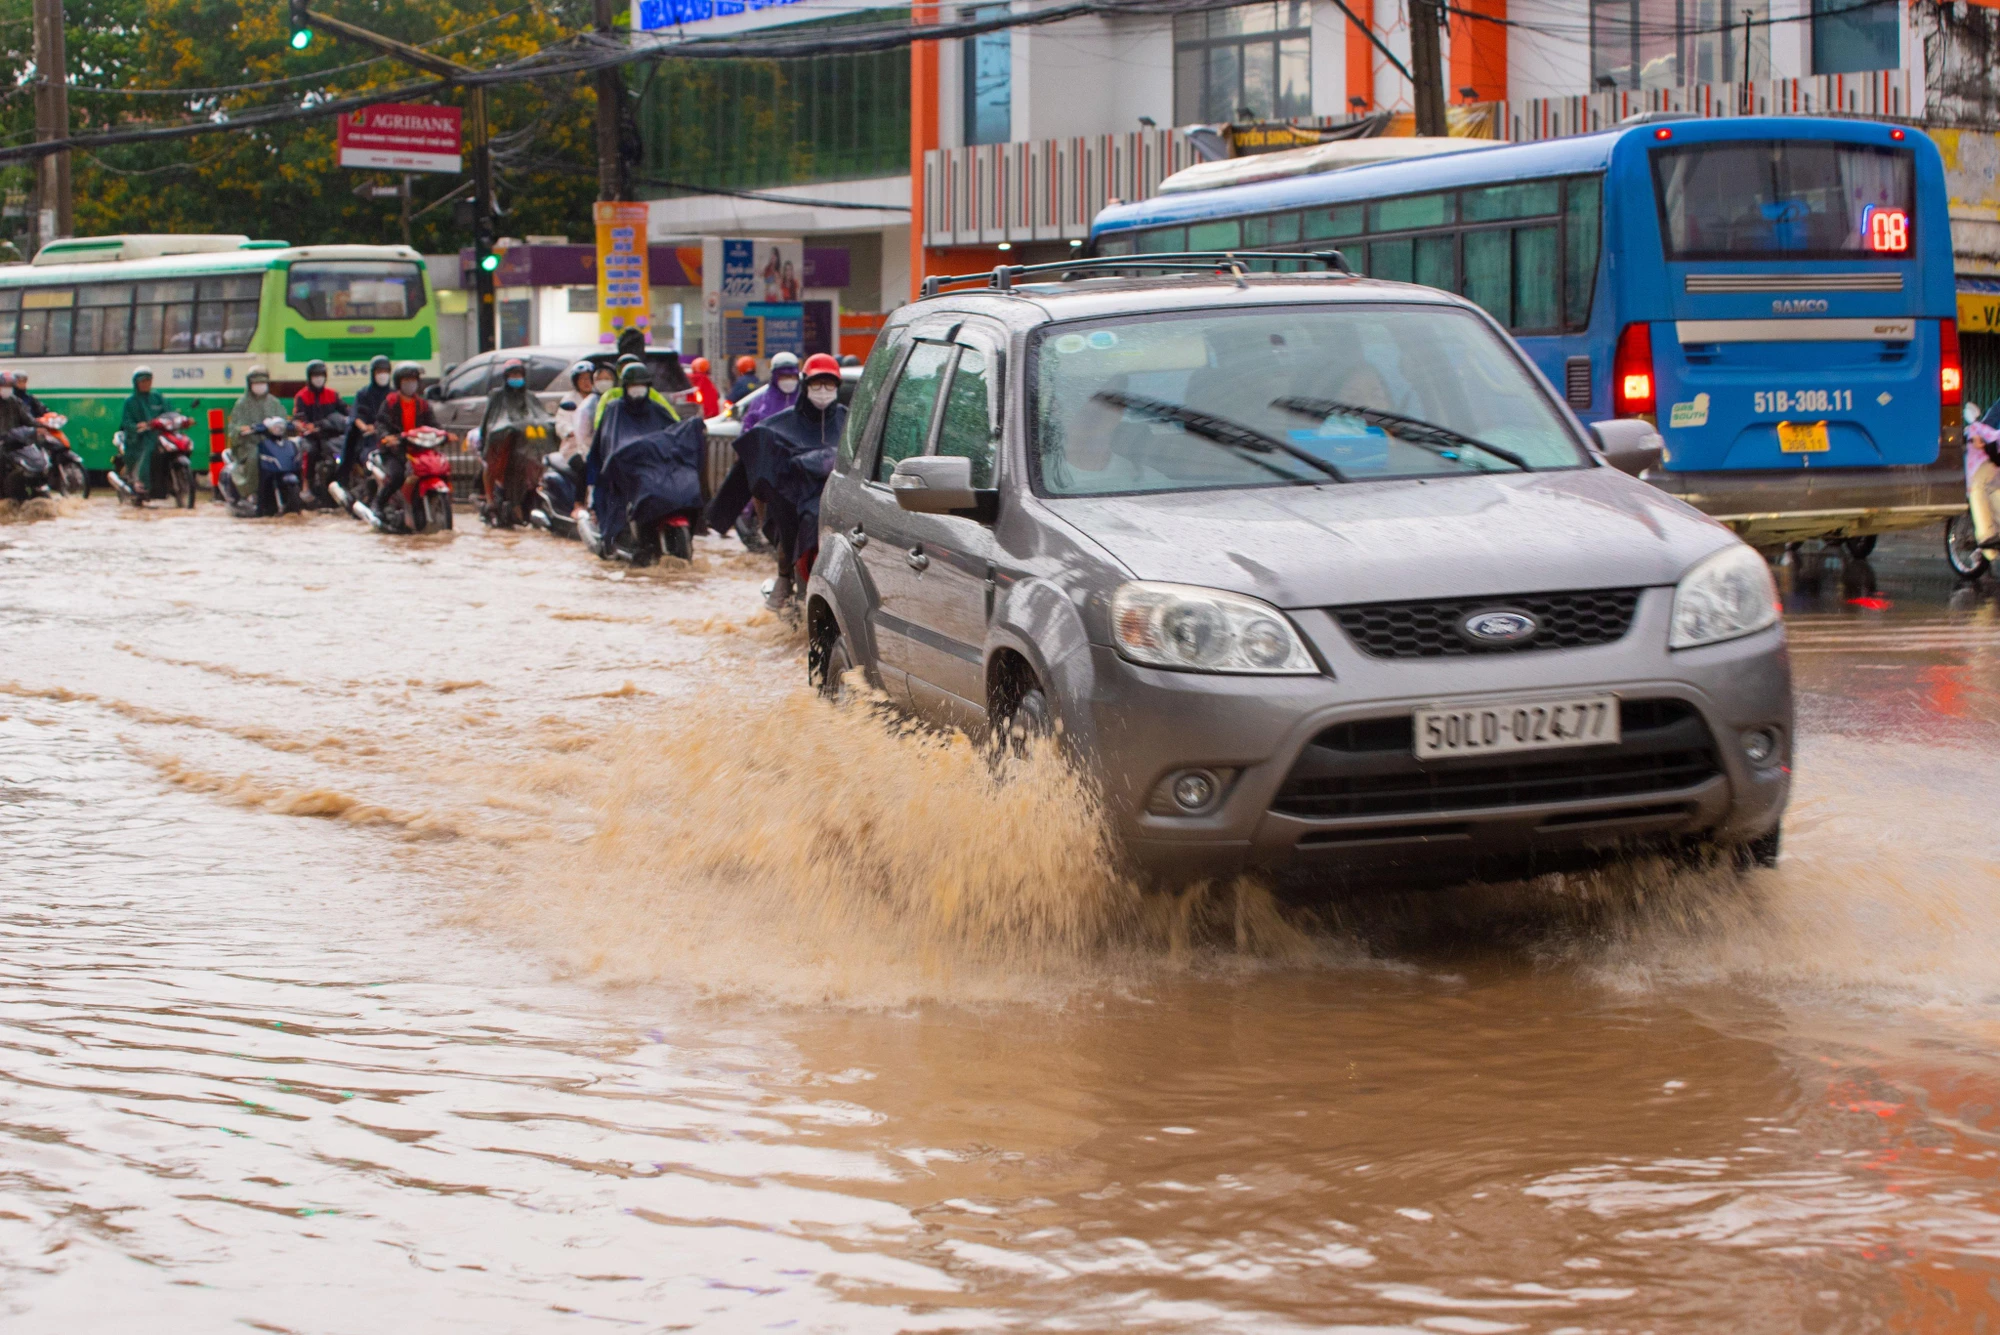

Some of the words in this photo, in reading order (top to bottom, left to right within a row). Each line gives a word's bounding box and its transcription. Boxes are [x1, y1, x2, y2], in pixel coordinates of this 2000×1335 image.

[371, 114, 456, 133] AGRIBANK
[1872, 212, 1907, 251] 08
[1772, 299, 1829, 314] SAMCO
[1754, 389, 1852, 413] 51B-308.11
[1672, 411, 1706, 421] SOUTH
